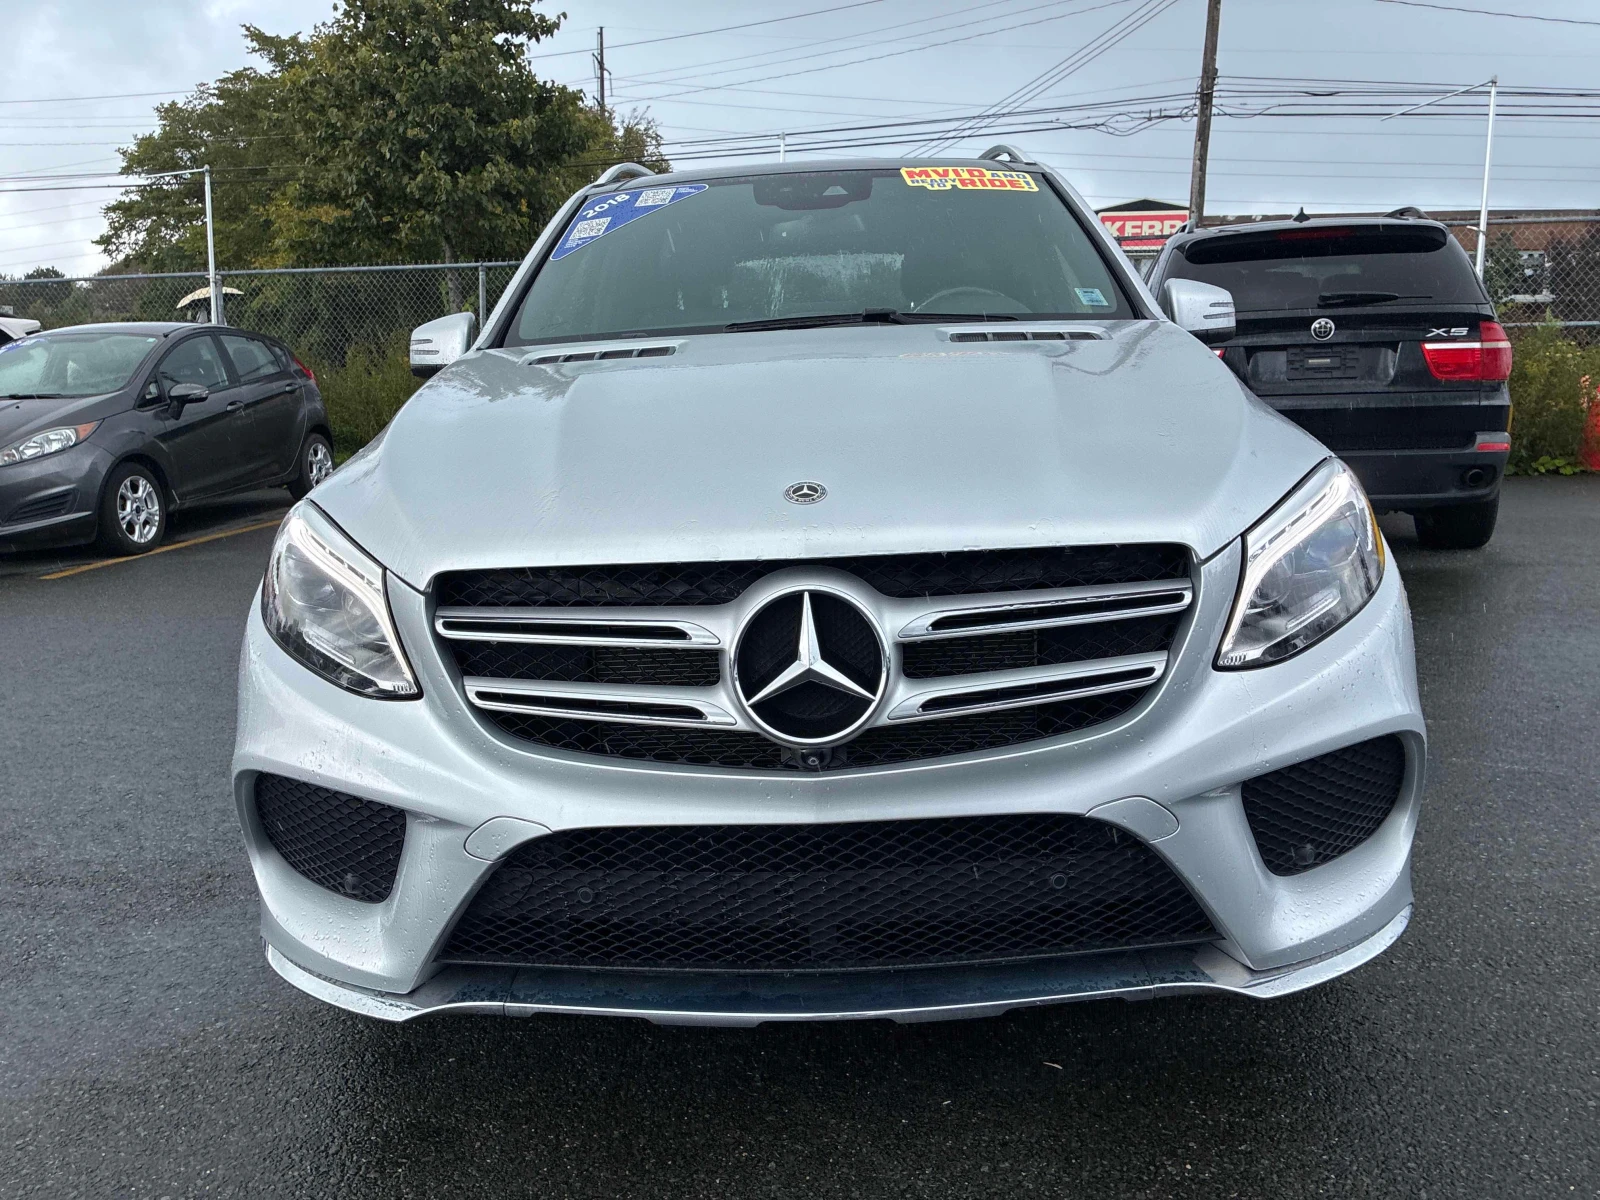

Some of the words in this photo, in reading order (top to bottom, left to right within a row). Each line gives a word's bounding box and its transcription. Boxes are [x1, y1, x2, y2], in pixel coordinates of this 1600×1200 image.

[904, 168, 987, 180] MVI'D
[990, 172, 1028, 180] AND
[957, 178, 1033, 189] RIDE!
[583, 193, 631, 218] 2018
[1425, 327, 1469, 338] X5
